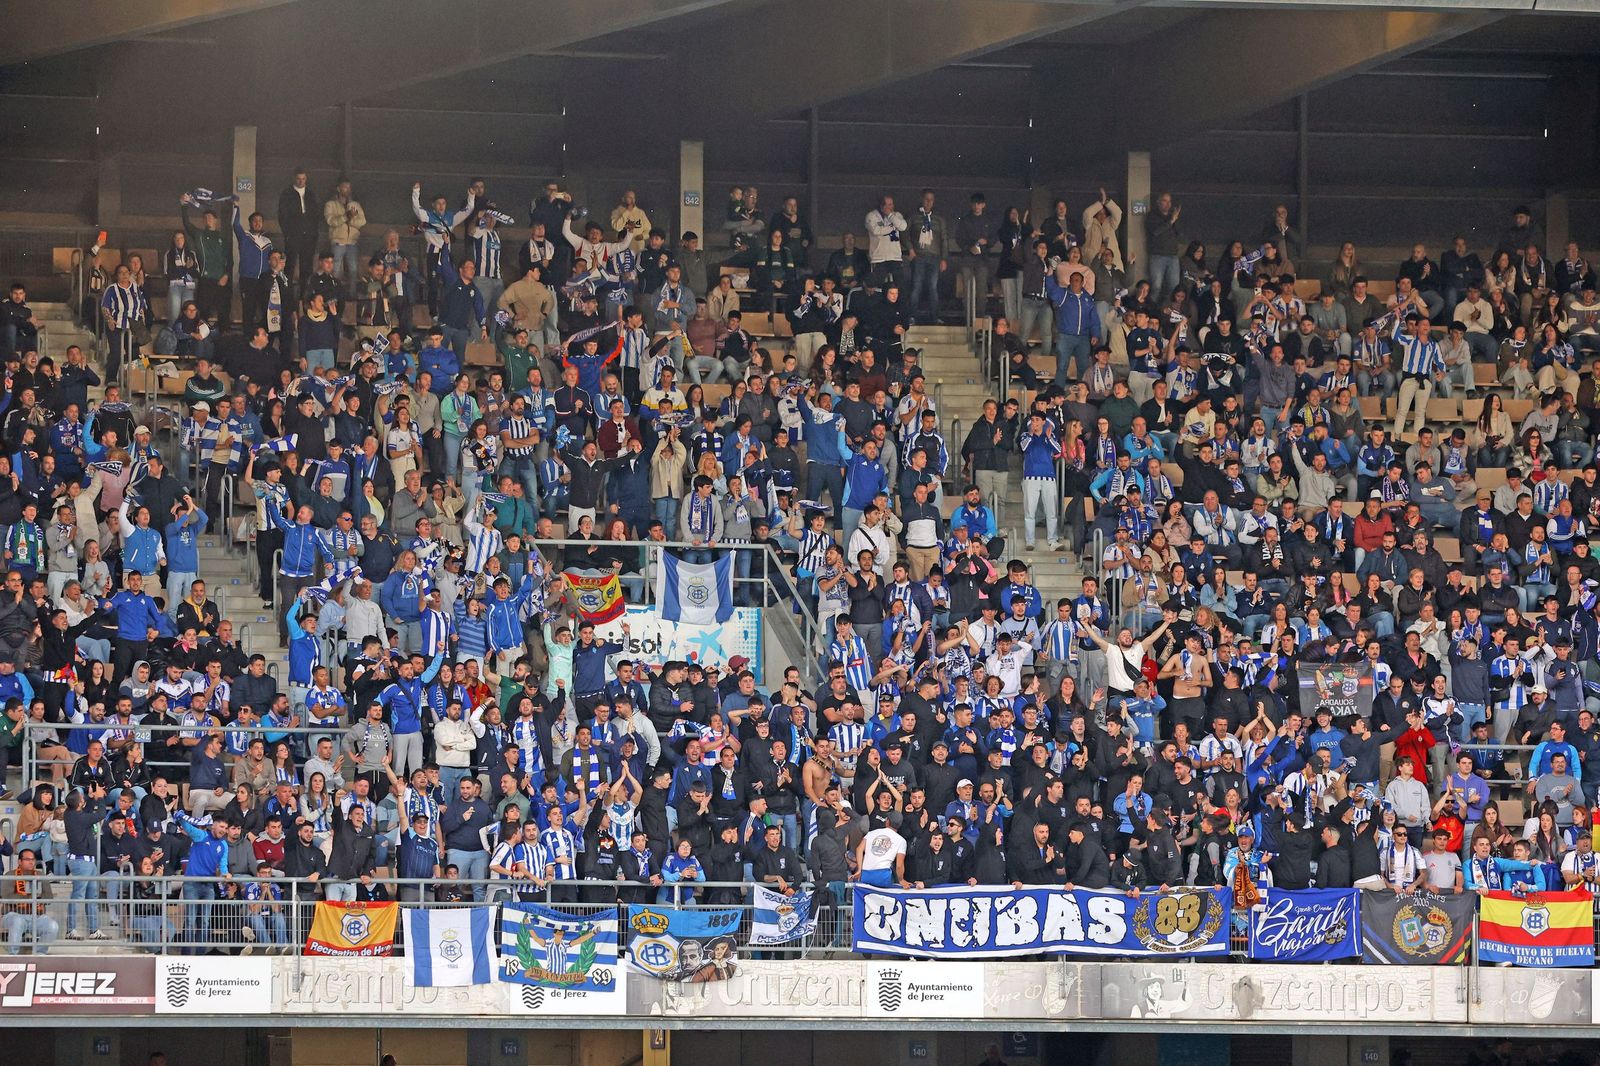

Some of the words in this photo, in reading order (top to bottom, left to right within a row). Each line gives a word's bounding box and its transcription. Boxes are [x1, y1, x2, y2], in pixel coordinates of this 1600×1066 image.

[238, 183, 252, 191] 342
[685, 197, 699, 205] 342
[1133, 206, 1146, 214] 341
[136, 731, 151, 740] 242
[1155, 894, 1201, 935] 83
[708, 912, 739, 928] 1889
[361, 947, 372, 956] de
[1480, 941, 1537, 956] RECREATIVO
[1540, 948, 1553, 957] DE
[1556, 947, 1592, 956] HUELVA
[1517, 957, 1554, 965] DECANO
[505, 959, 518, 976] 18
[591, 968, 612, 985] 89
[195, 977, 260, 988] Ayuntamiento
[196, 987, 207, 996] de
[209, 987, 232, 998] Jerez
[907, 982, 973, 994] Ayuntamiento
[551, 989, 562, 998] de
[564, 990, 587, 1002] Jerez
[908, 992, 919, 1001] de
[921, 993, 945, 1004] Jerez
[504, 1046, 517, 1054] 141
[912, 1048, 927, 1057] 140
[1364, 1053, 1379, 1061] 140
